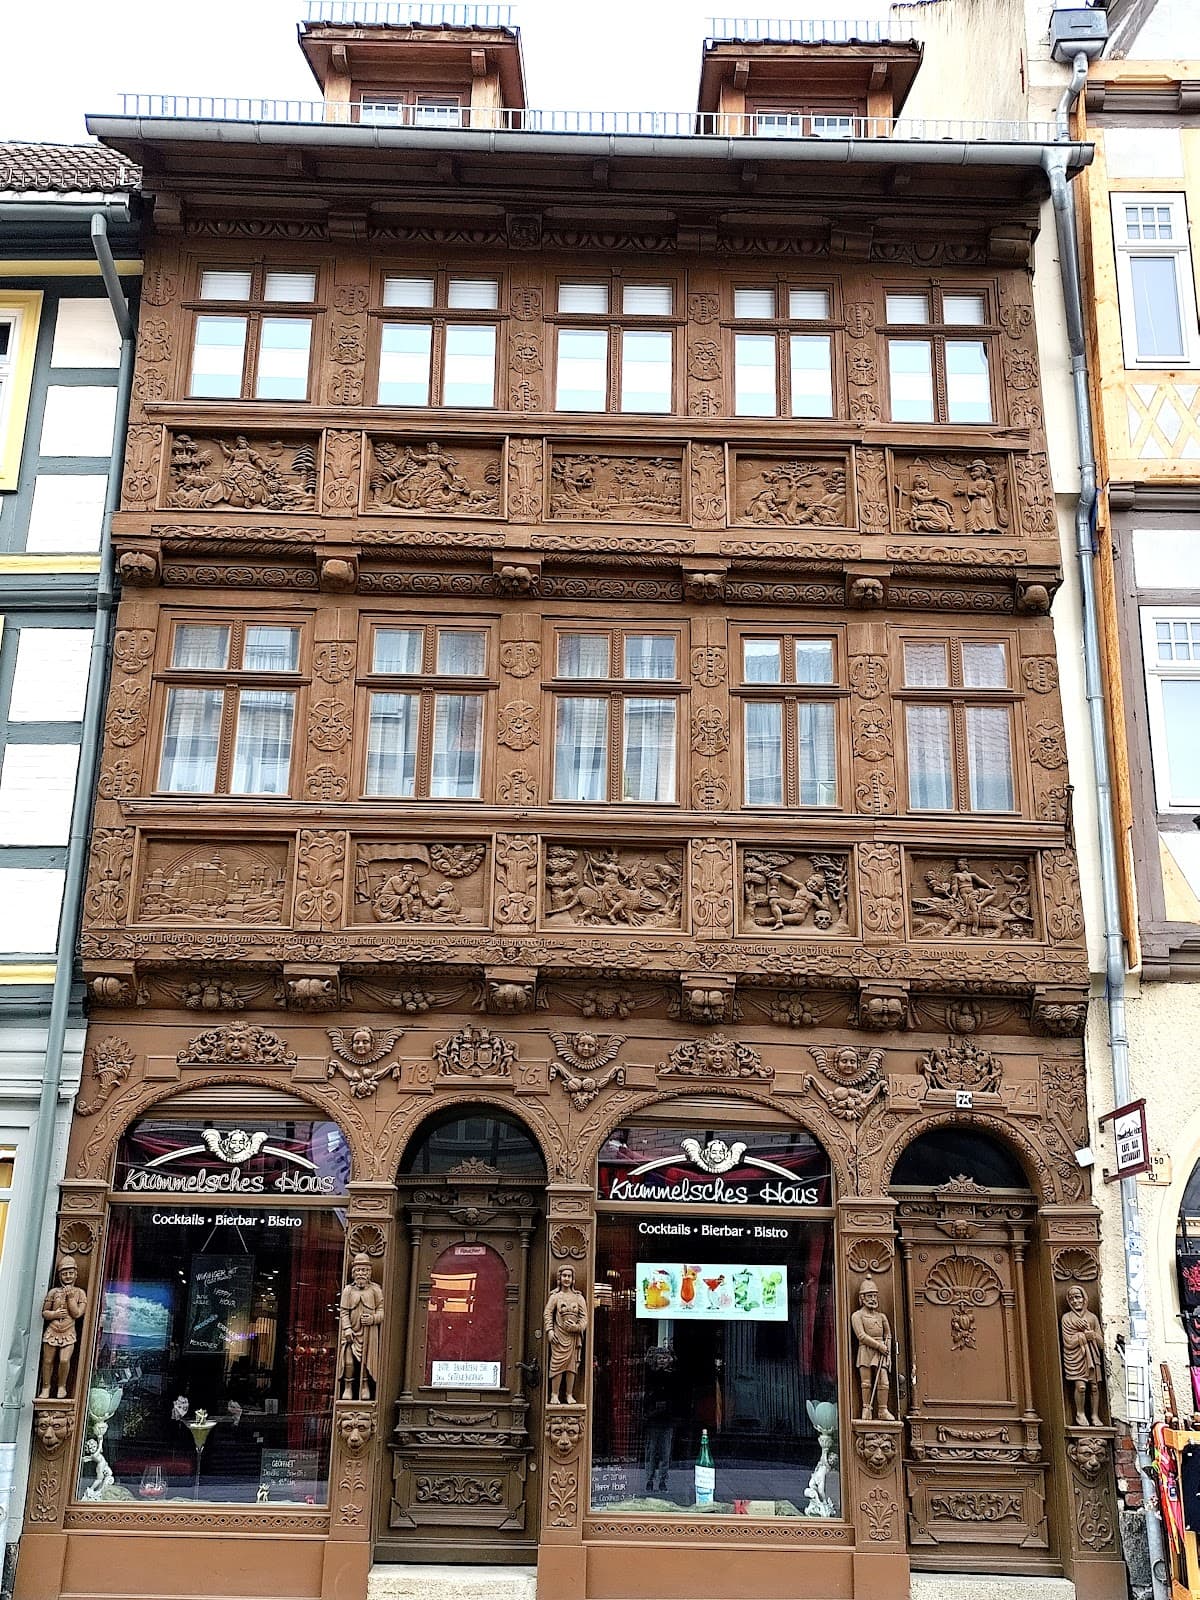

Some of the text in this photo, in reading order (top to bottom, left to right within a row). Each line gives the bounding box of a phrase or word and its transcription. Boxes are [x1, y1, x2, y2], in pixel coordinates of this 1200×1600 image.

[1004, 1085, 1039, 1105] 74
[123, 1167, 336, 1193] Krummelsches Haus
[609, 1178, 819, 1205] Krummelsches Haus
[152, 1213, 302, 1227] Cocktails Bierbar Bistro
[638, 1222, 789, 1239] Cocktails Bierbar Bistro
